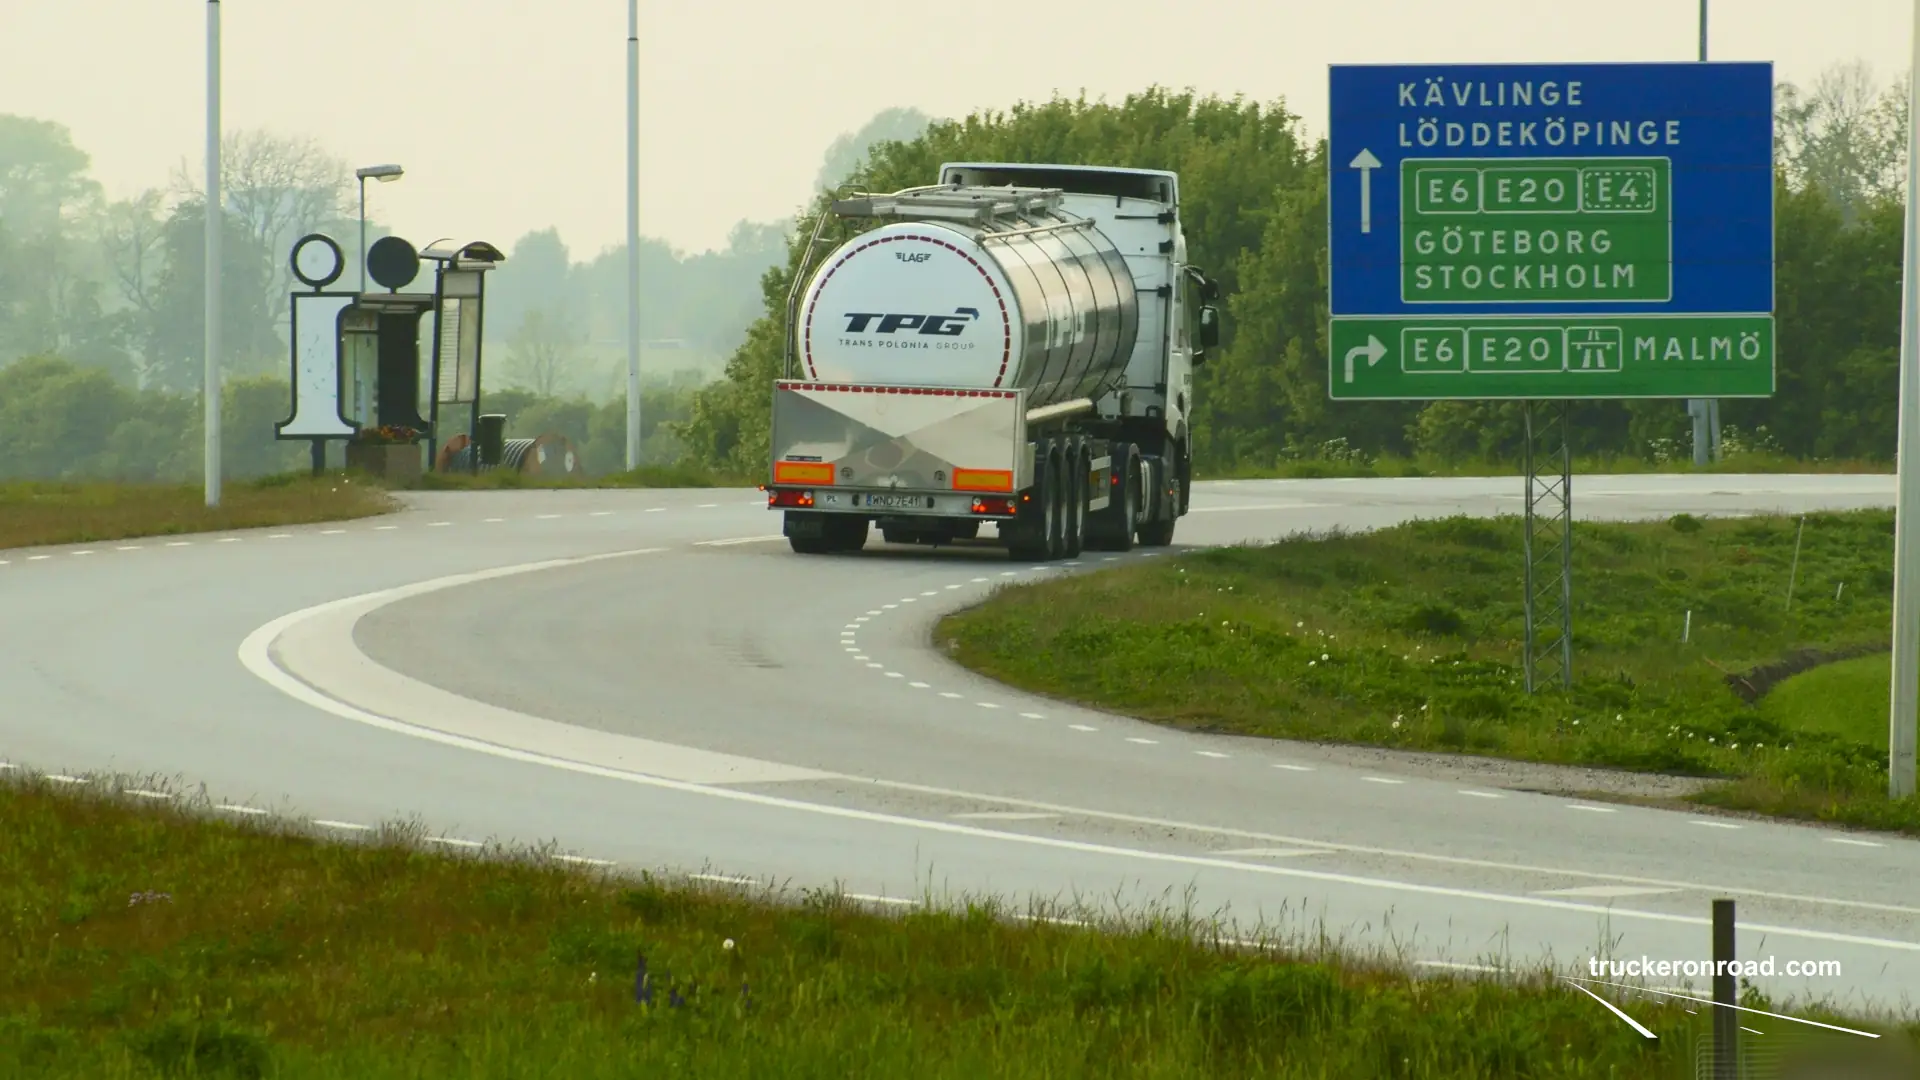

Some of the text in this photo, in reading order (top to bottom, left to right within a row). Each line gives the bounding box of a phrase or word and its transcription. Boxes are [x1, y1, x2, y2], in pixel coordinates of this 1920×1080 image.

[1399, 76, 1582, 107] KÄVLINGE
[1399, 116, 1681, 148] LÖDDEKÖPINGE
[1429, 177, 1639, 203] E6 E20 E4
[1415, 226, 1612, 255] GÖTEBORG
[902, 252, 924, 263] LAG
[1415, 264, 1635, 289] STOCKHOLM
[844, 312, 971, 337] TPG
[839, 338, 975, 350] TRANS POLONIA GROUP
[1414, 331, 1761, 362] E6 E20 MALMÖ
